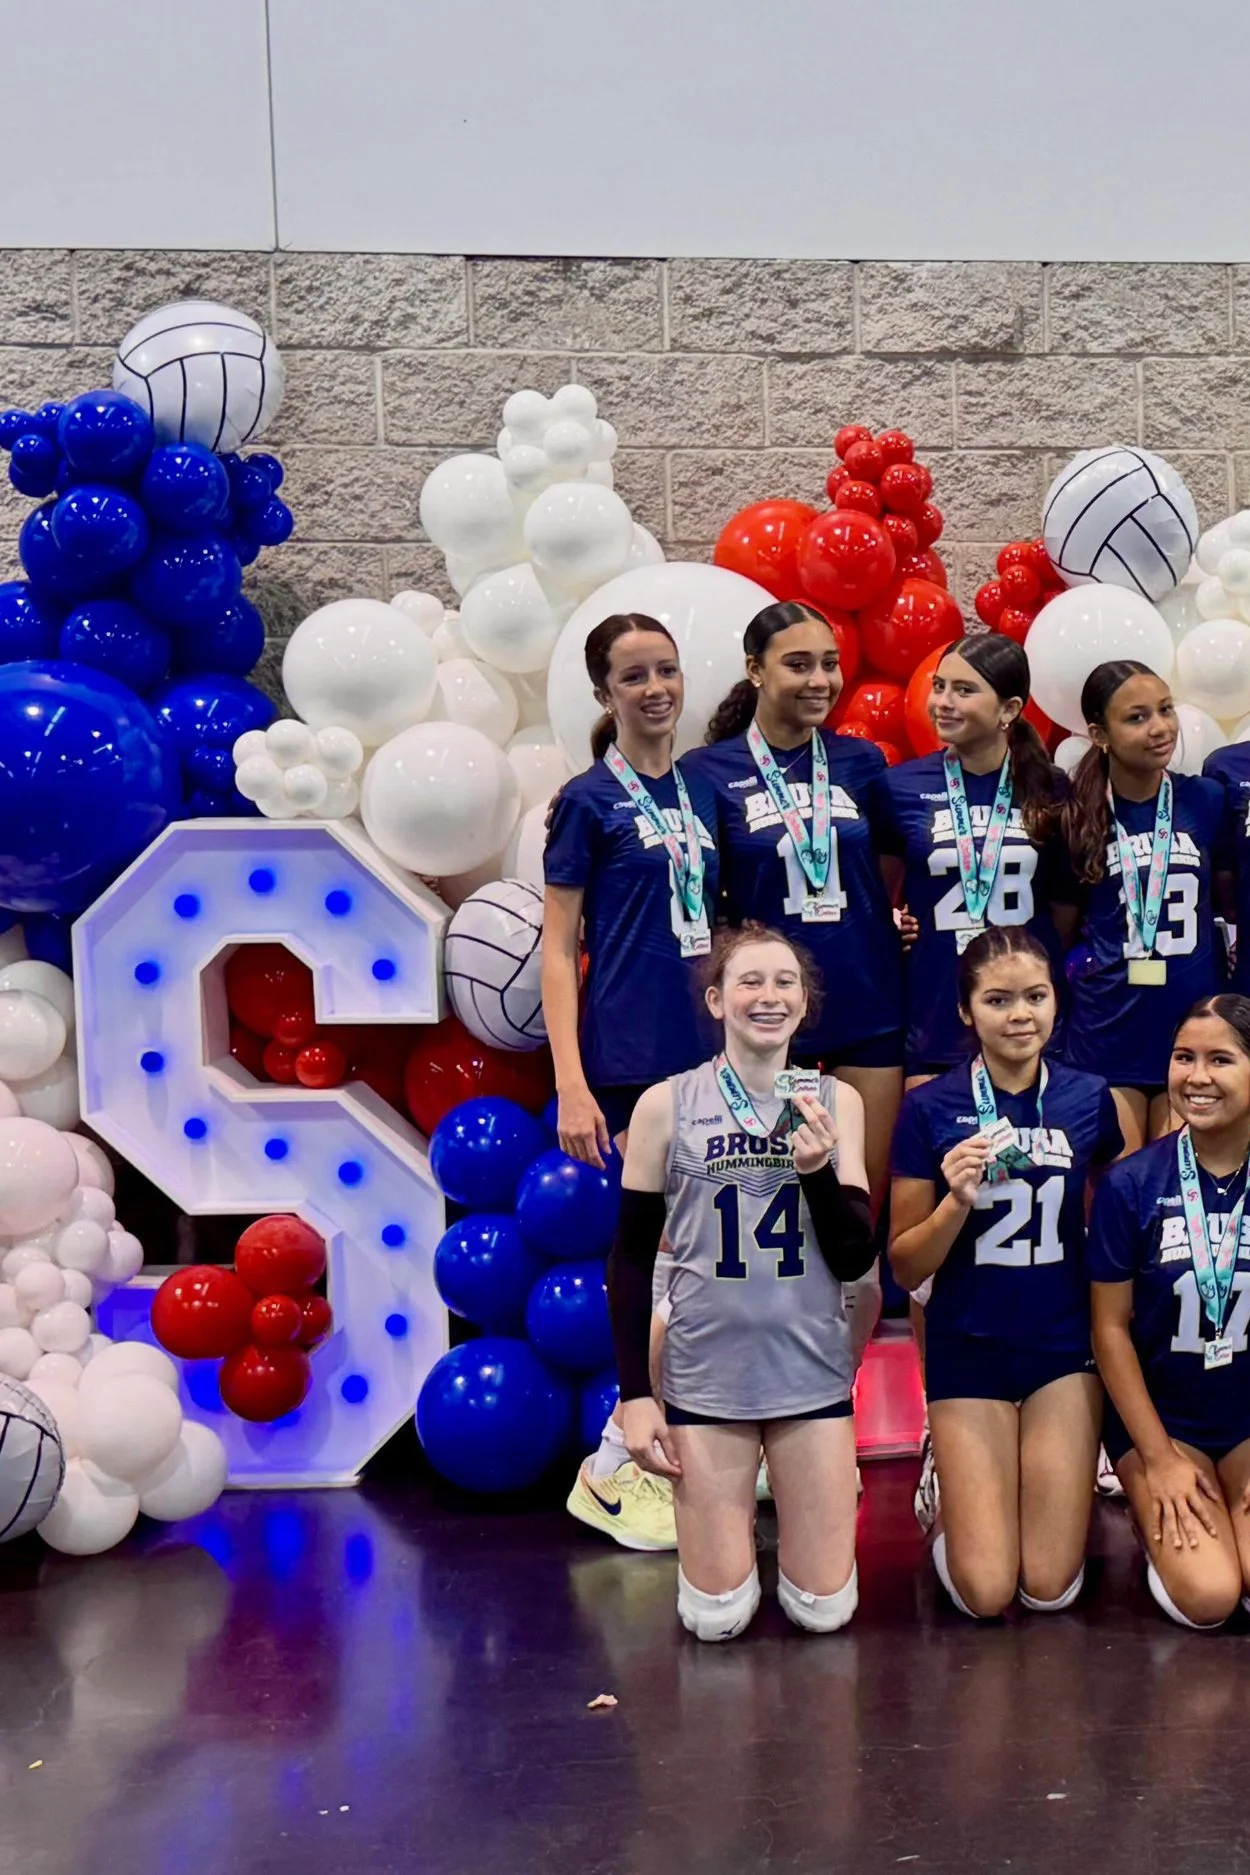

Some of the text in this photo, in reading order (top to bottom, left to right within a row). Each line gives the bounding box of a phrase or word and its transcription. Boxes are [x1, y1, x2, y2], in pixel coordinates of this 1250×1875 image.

[745, 782, 858, 822] BUA
[634, 808, 714, 840] BUA
[928, 845, 1039, 931] 28
[720, 1067, 748, 1111] Summer
[691, 1115, 722, 1126] capelli
[72, 819, 452, 1487] S
[704, 1133, 794, 1162] BRUS
[707, 1157, 794, 1175] HUMMINGBIR
[713, 1183, 805, 1281] 14
[973, 1175, 1065, 1266] 21
